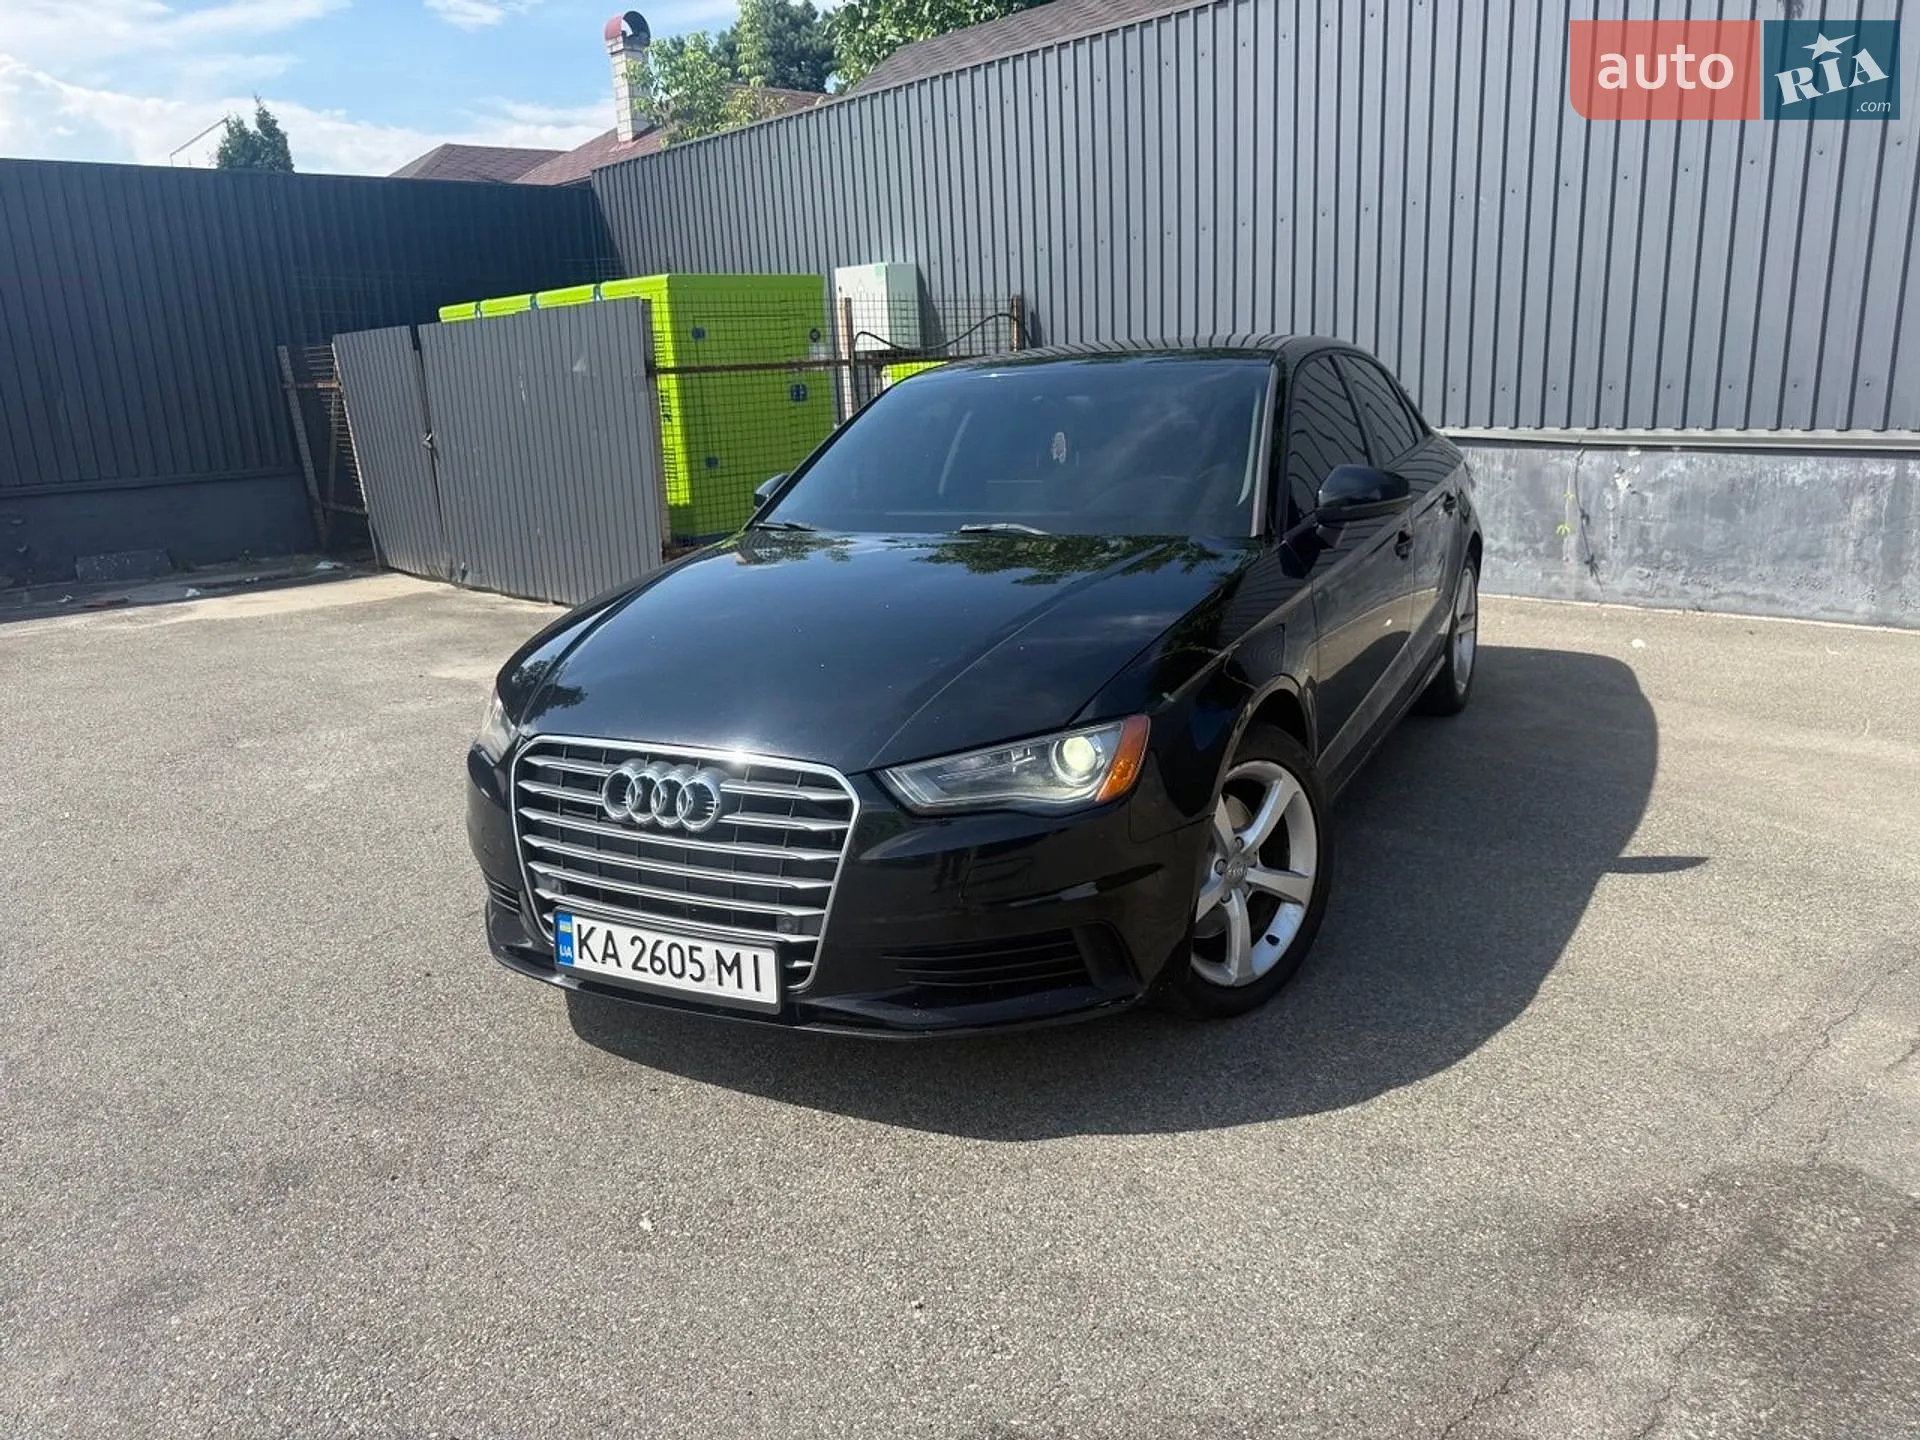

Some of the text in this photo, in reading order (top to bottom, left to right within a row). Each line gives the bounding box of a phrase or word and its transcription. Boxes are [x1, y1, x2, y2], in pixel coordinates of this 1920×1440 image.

[559, 944, 573, 959] UA
[577, 924, 761, 992] KA 2605 MI
